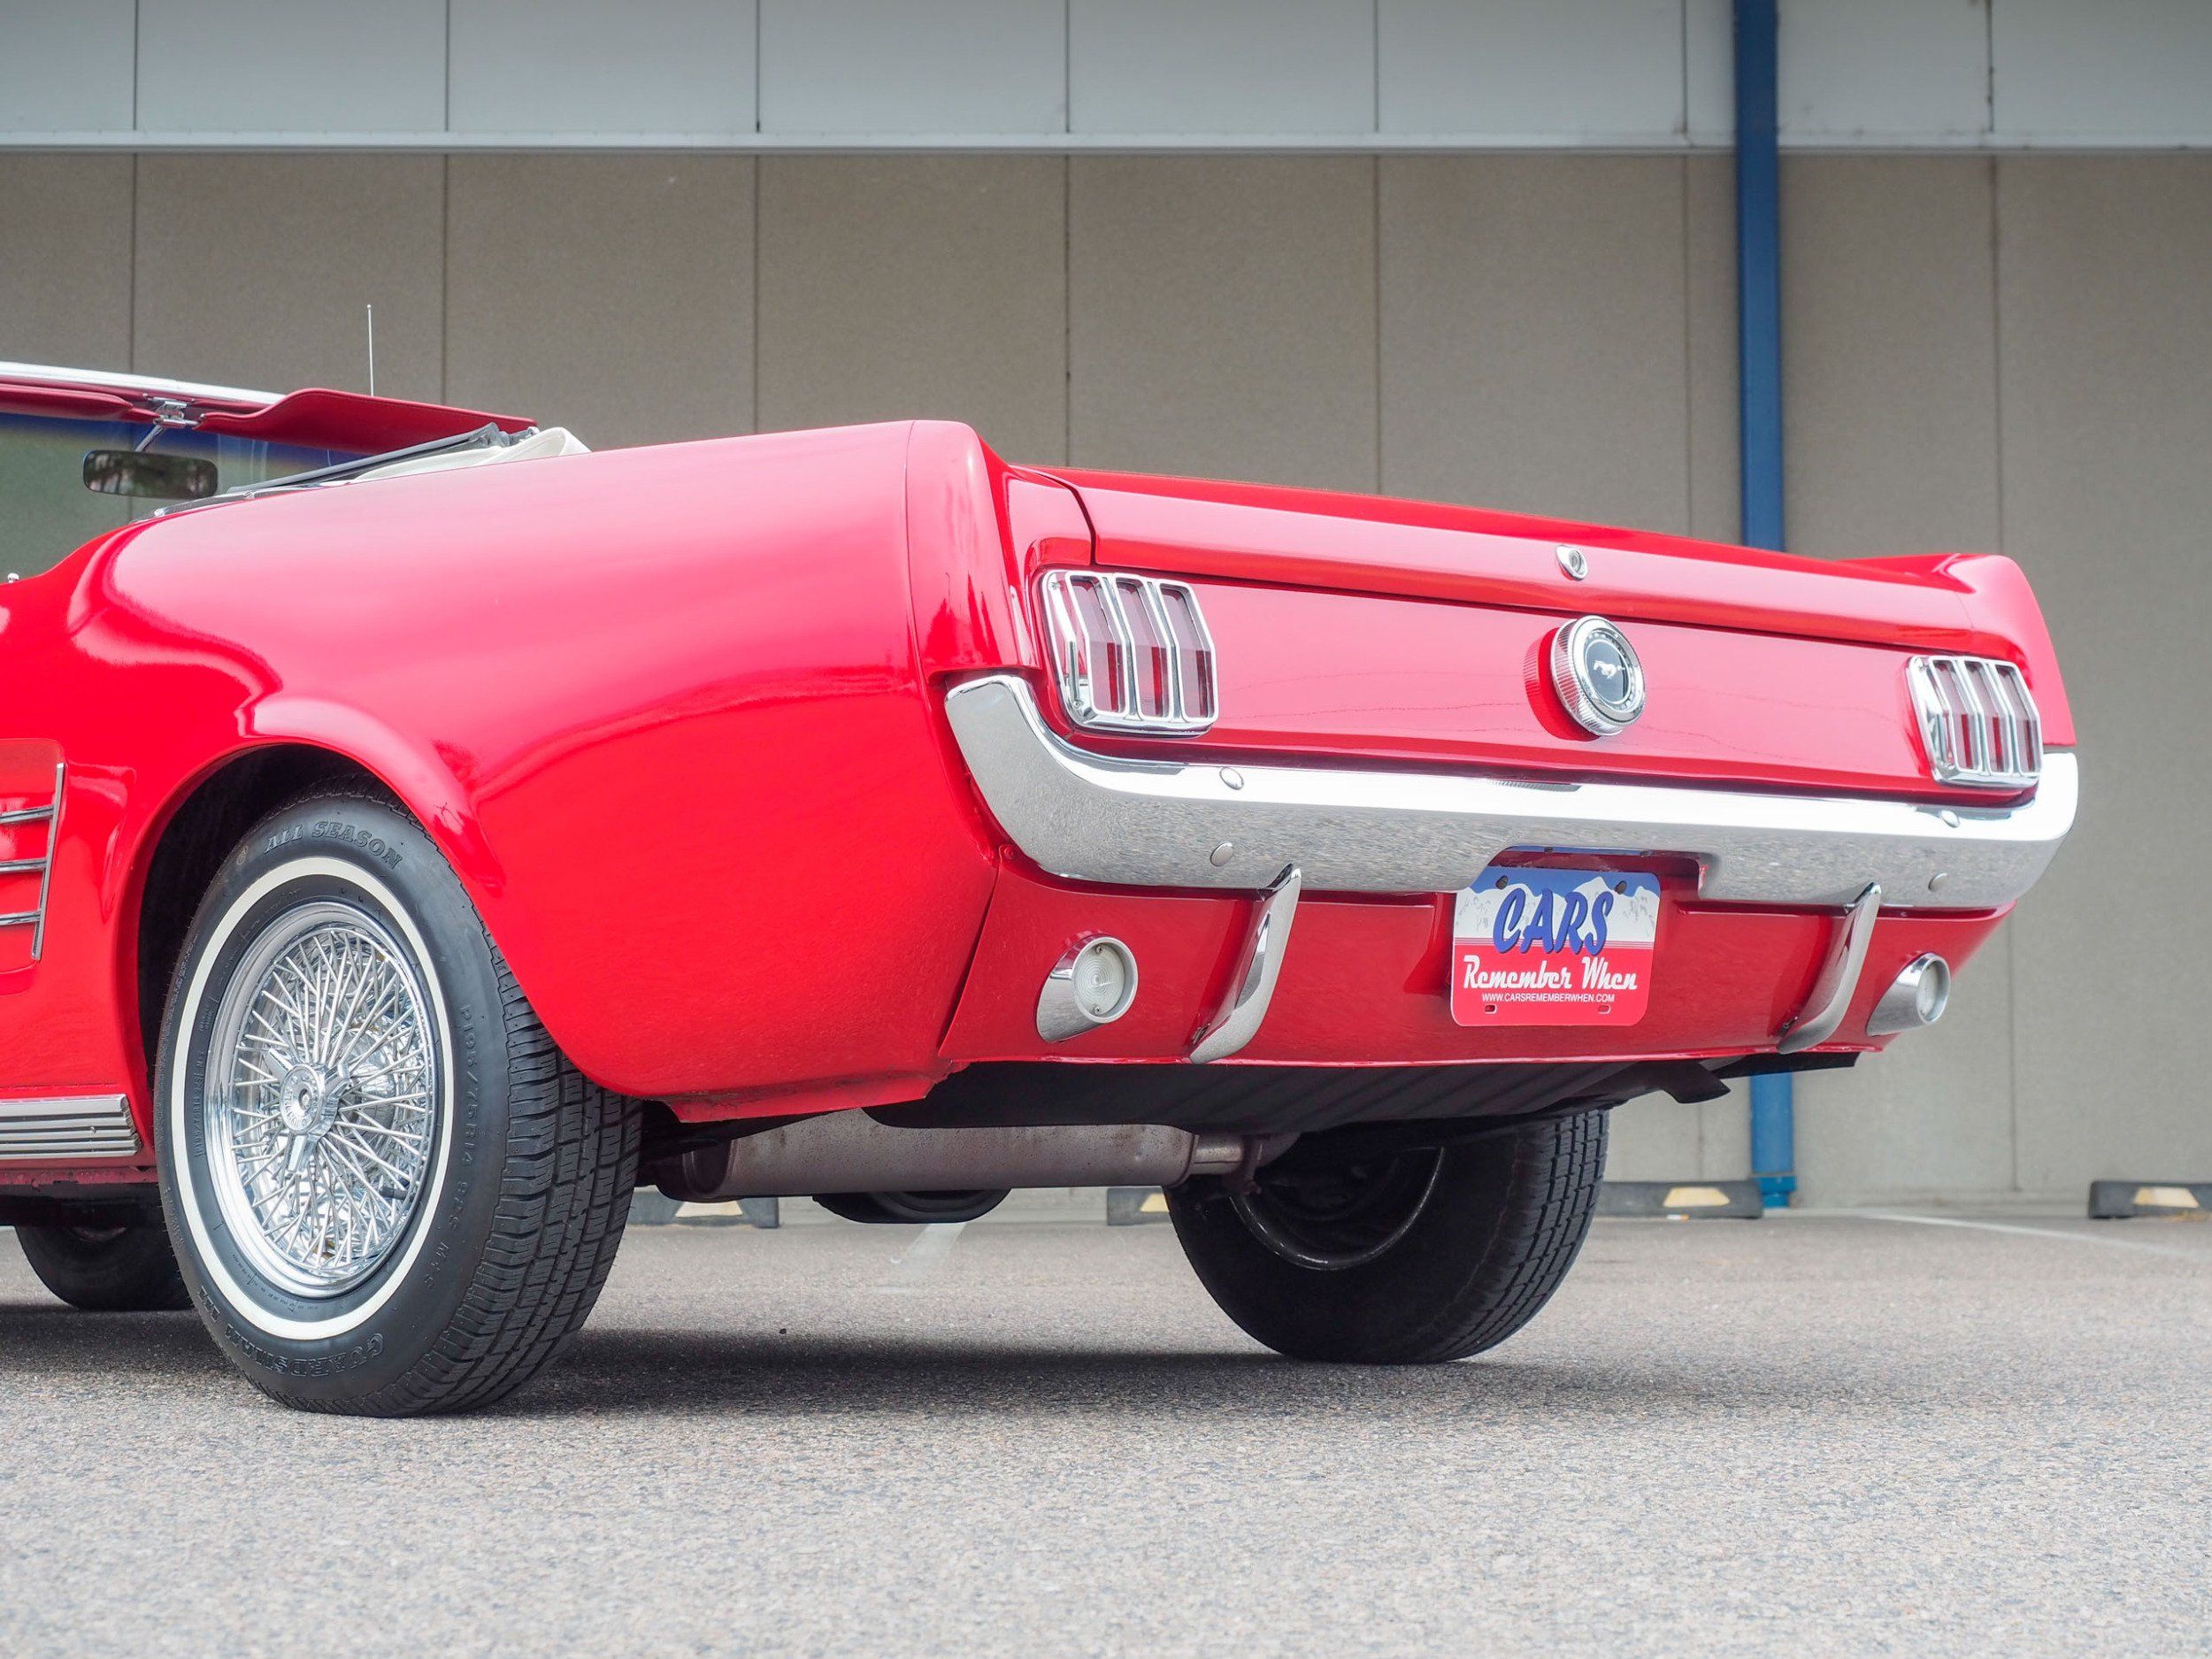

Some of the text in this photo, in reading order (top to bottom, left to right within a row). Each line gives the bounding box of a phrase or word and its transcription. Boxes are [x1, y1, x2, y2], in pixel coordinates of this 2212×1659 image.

[264, 820, 403, 870] ALL SEASON
[1493, 887, 1614, 955] CARS
[1463, 954, 1638, 990] Remember When
[1482, 992, 1615, 1003] WWW.CARSREMEMBERWHEN.COM
[224, 1324, 385, 1377] GUARDSMAN
